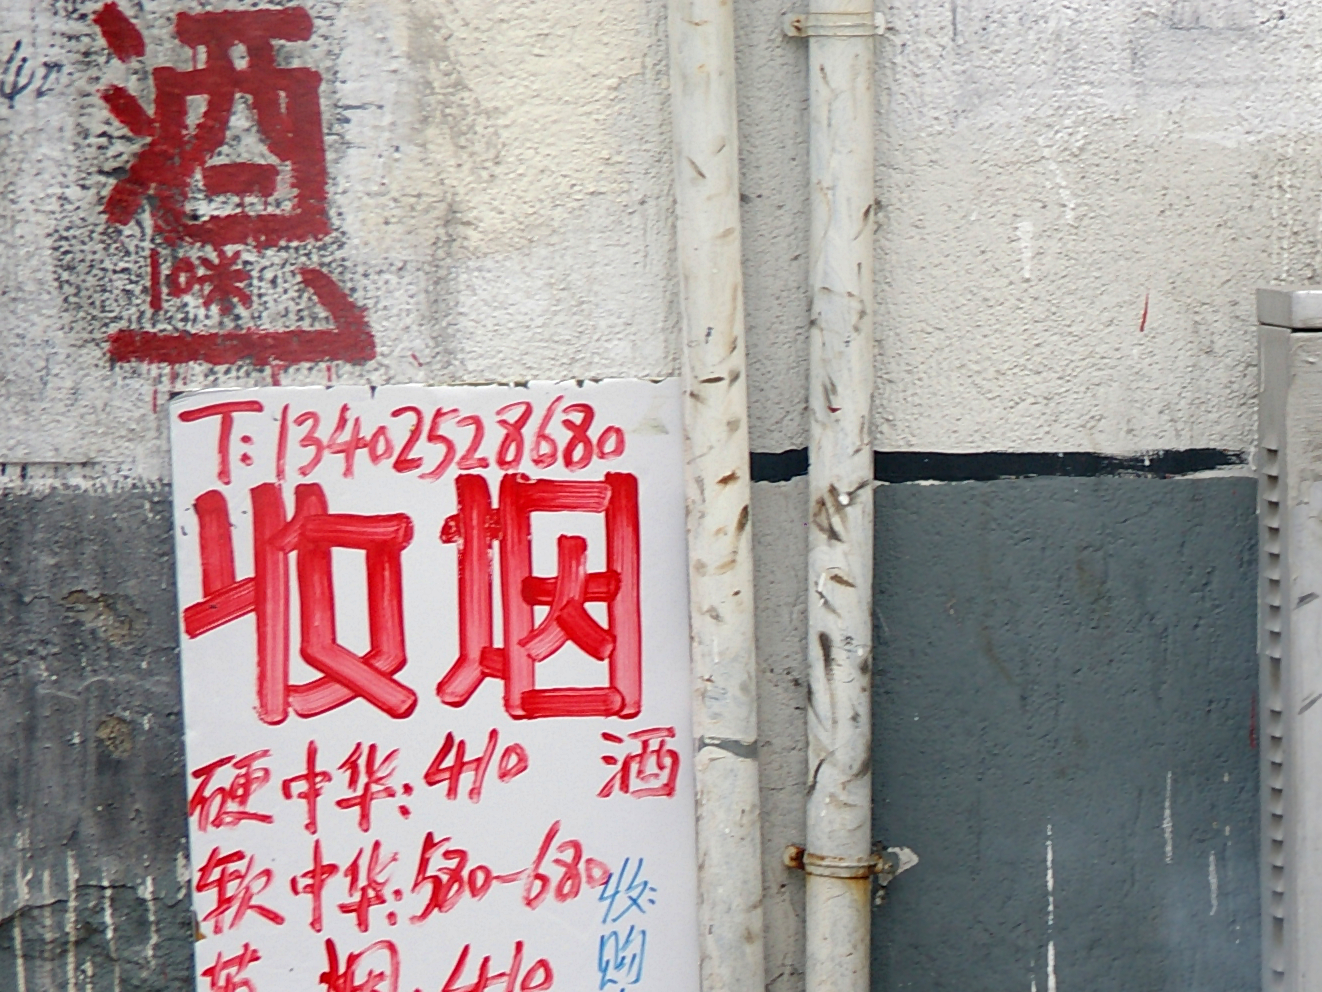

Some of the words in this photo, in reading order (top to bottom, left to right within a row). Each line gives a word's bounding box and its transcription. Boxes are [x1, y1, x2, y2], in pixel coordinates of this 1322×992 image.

[92, 2, 332, 247] 酒
[182, 471, 643, 726] 收烟
[597, 726, 681, 799] 酒
